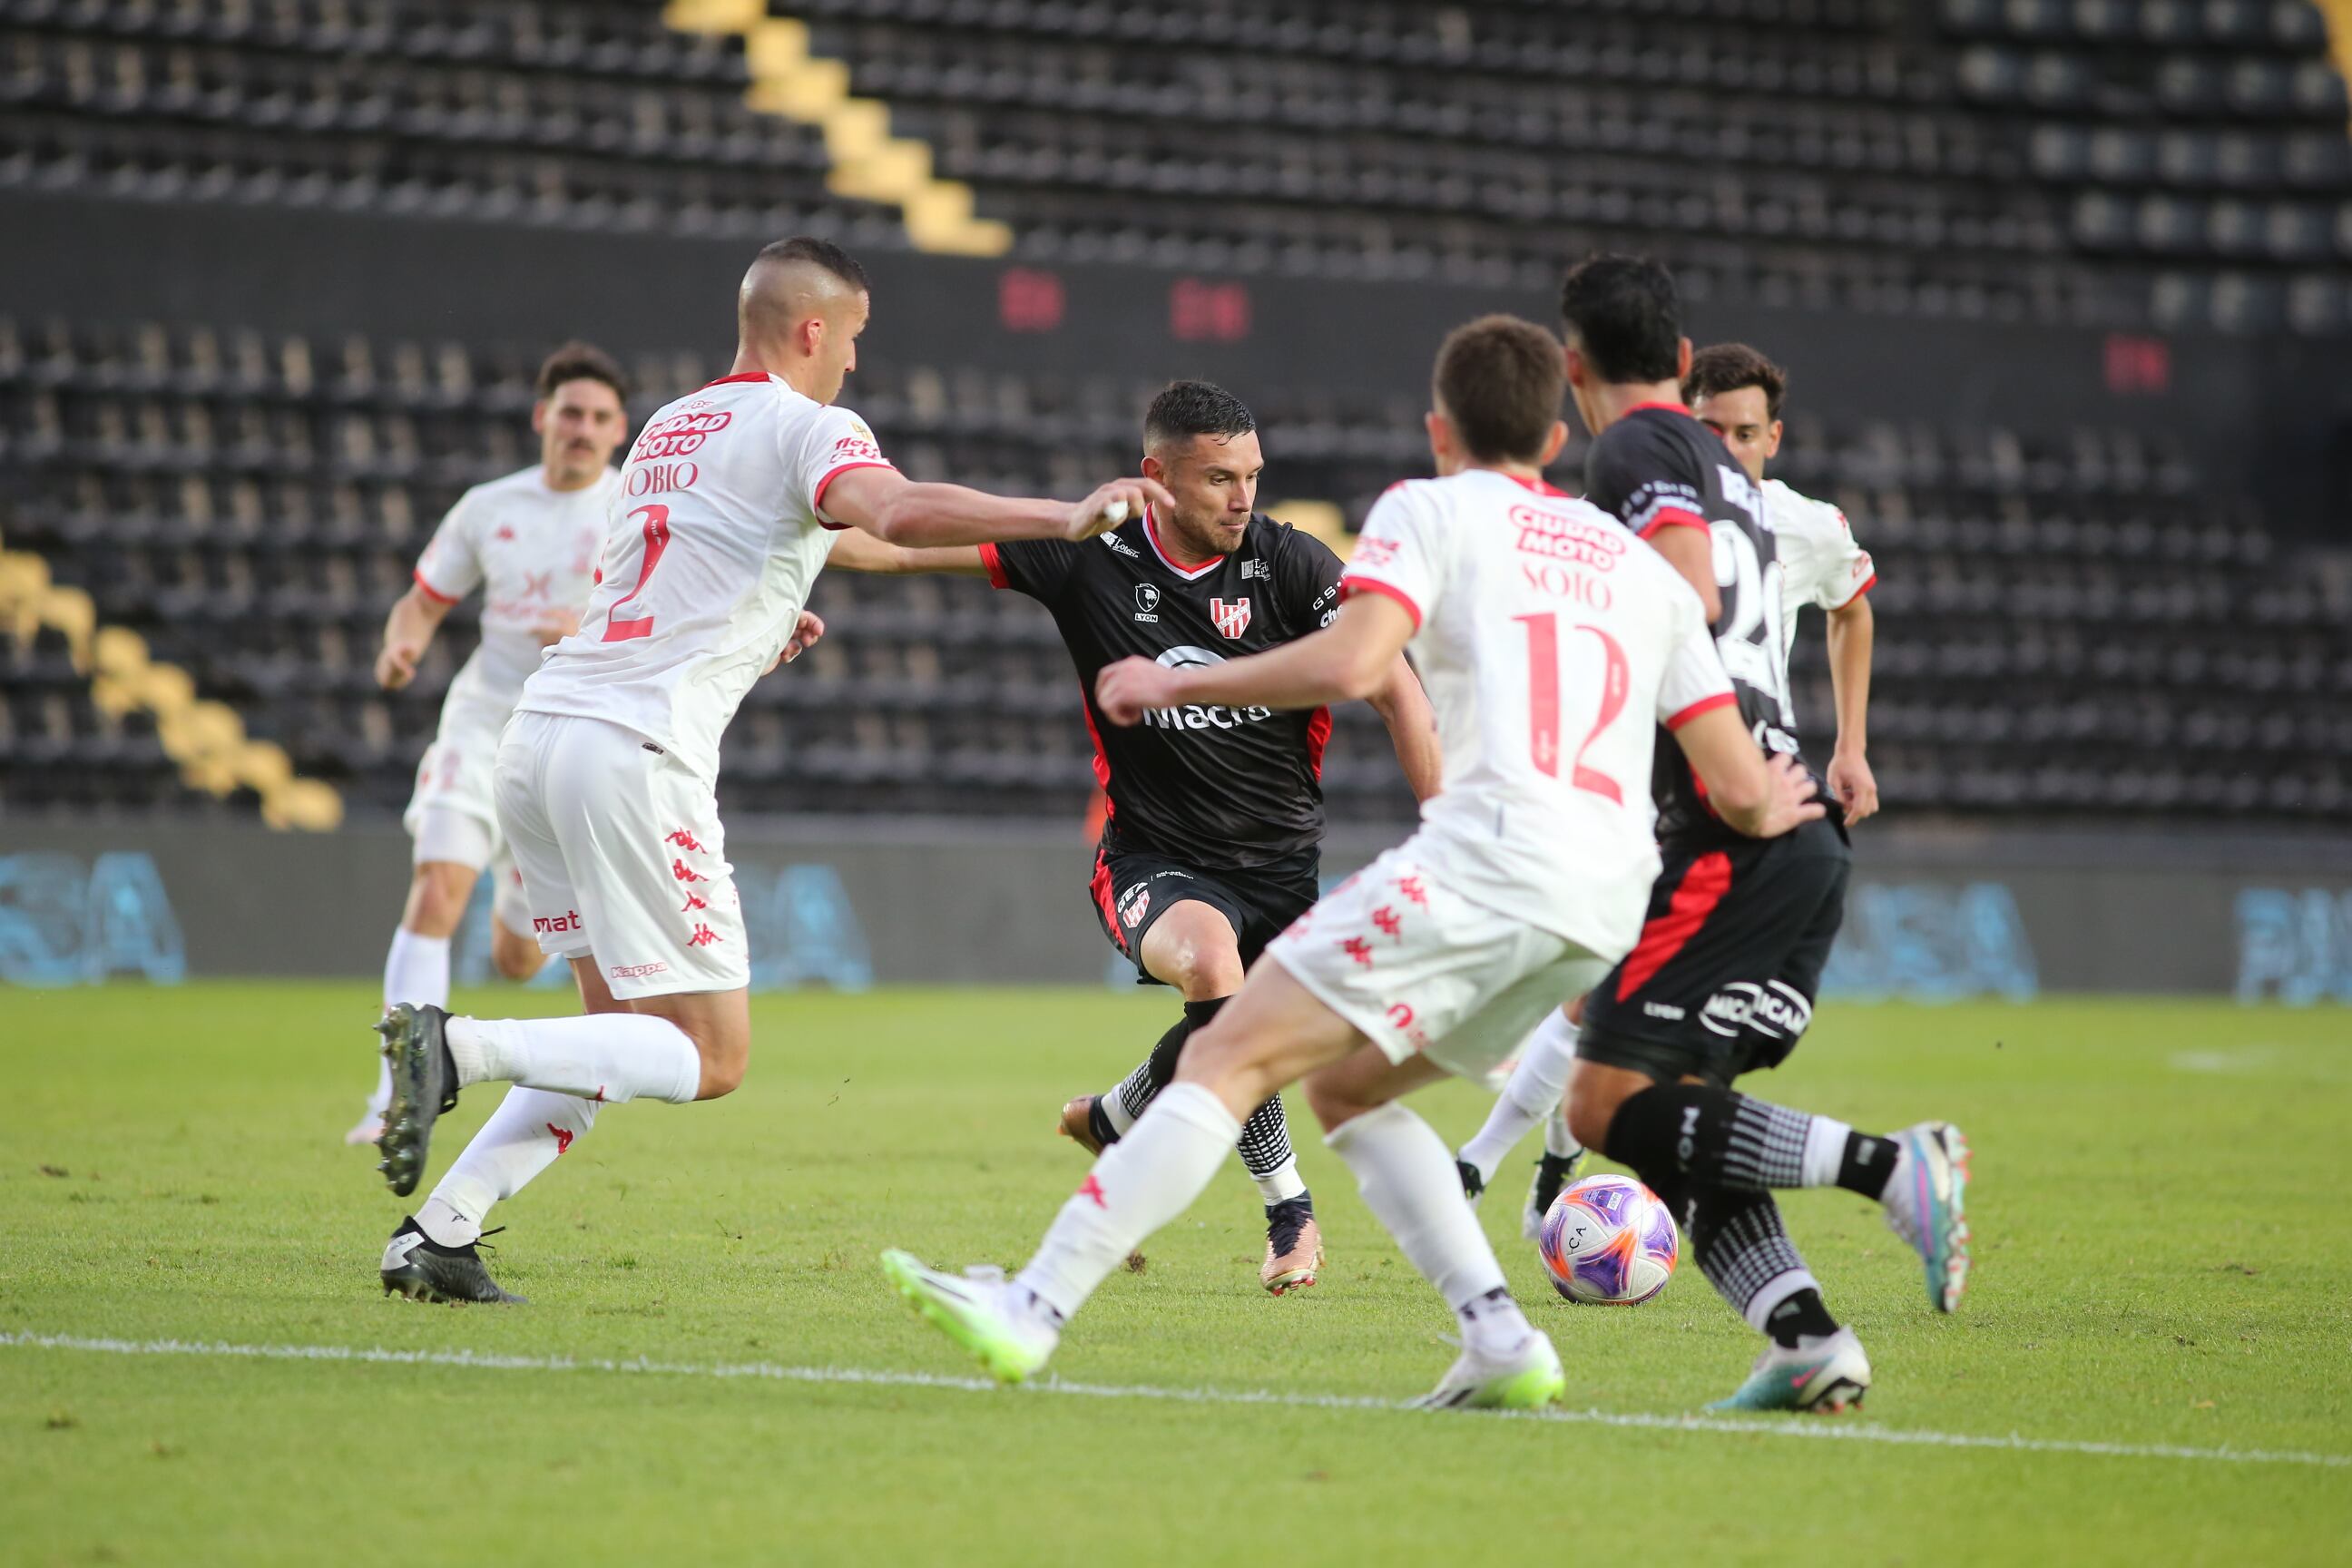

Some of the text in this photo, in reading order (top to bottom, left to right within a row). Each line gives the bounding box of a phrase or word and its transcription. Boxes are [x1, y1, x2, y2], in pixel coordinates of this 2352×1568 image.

[1509, 505, 1626, 554] CIUDAD
[1516, 527, 1614, 573] MOTO
[601, 504, 671, 642] 2
[1134, 612, 1159, 623] LYON
[1143, 703, 1271, 730] Macro
[1511, 612, 1631, 809] 12
[611, 962, 668, 978] Kappa
